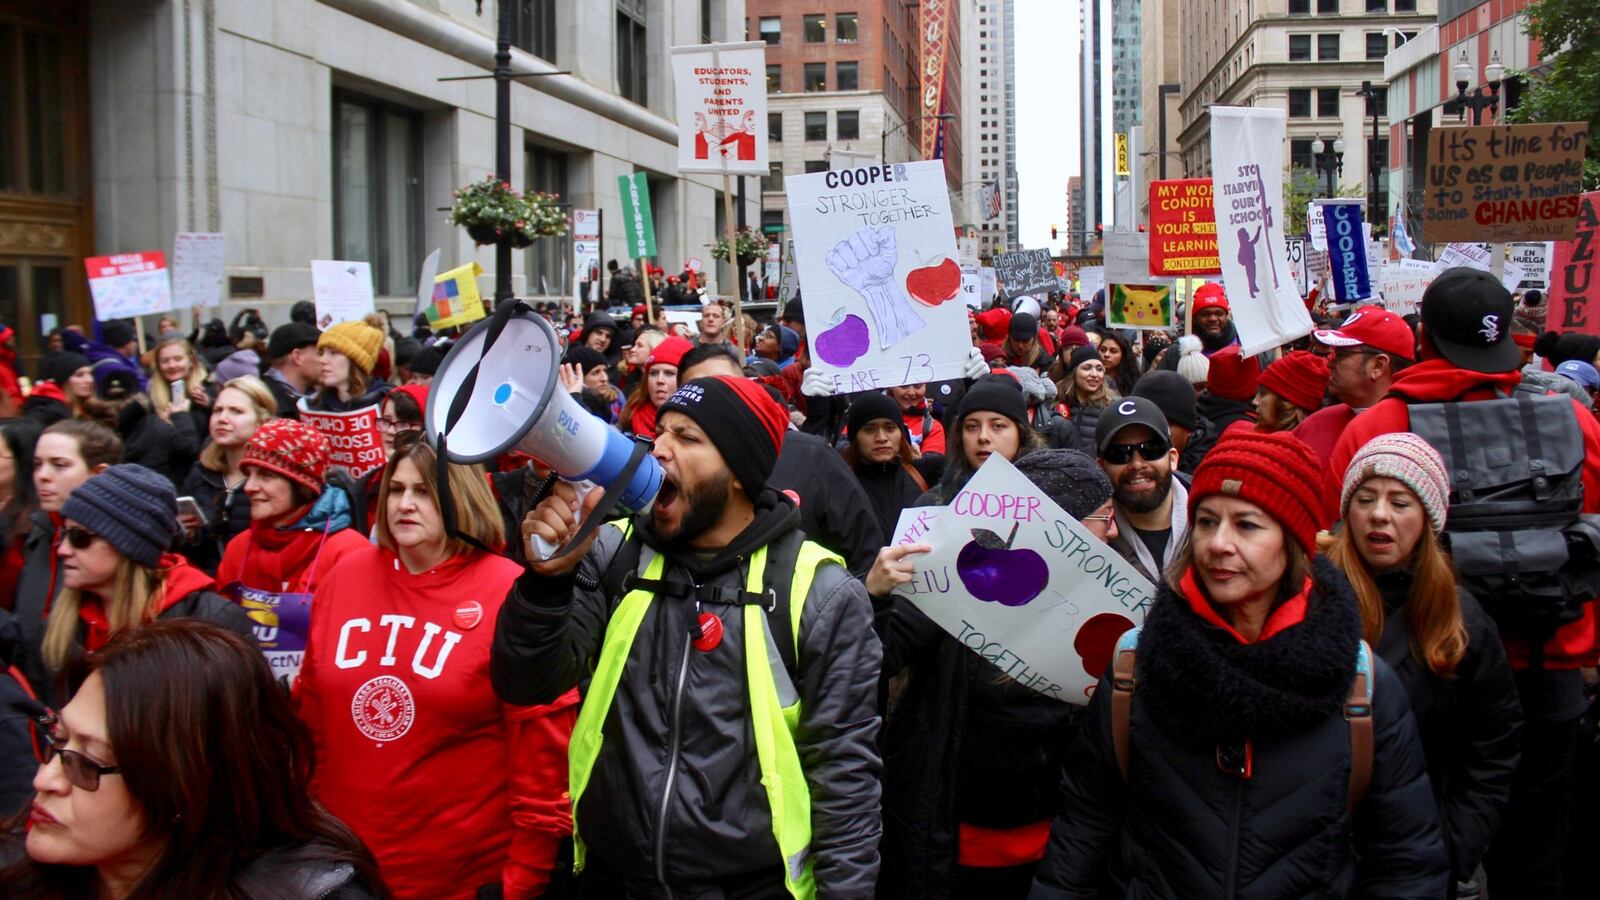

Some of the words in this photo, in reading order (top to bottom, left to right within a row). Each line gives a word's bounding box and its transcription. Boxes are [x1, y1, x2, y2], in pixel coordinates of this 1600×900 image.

[925, 0, 941, 107] ace
[694, 68, 752, 76] EDUCATORS,
[699, 78, 748, 86] STUDENTS,
[708, 108, 740, 116] UNITED
[1118, 134, 1126, 172] PARK
[1439, 129, 1477, 163] It's
[1486, 126, 1543, 159] time
[1547, 125, 1587, 152] for
[825, 164, 909, 189] COOPER
[1238, 164, 1257, 177] STO
[1499, 164, 1519, 182] a
[1158, 186, 1178, 197] MY
[1223, 180, 1258, 195] STARVI
[1434, 187, 1463, 207] to
[816, 188, 917, 214] STRONGER
[1232, 197, 1255, 210] OUR
[1475, 196, 1580, 225] CHANGES
[857, 204, 939, 226] TOGETHER
[1183, 211, 1196, 222] IS
[1230, 210, 1262, 225] SCHOO
[1156, 223, 1190, 235] YOUR
[1163, 240, 1218, 252] LEARNIN
[1334, 205, 1361, 300] COOPER
[993, 251, 1033, 268] FIGHTING
[1035, 248, 1051, 262] FOR
[1164, 258, 1221, 269] CONDITION
[1562, 198, 1600, 334] AZUE
[996, 267, 1014, 280] THE
[1041, 261, 1053, 275] OF
[830, 374, 844, 395] E
[850, 368, 880, 392] ARE
[899, 353, 934, 384] 73
[1118, 401, 1137, 415] C
[348, 415, 371, 432] DE
[558, 410, 580, 436] PYLE
[324, 432, 373, 449] ESCOL
[358, 447, 383, 462] LOS
[954, 490, 1046, 523] COOPER
[1044, 519, 1153, 617] STRONGER
[242, 591, 264, 602] CAL
[264, 595, 280, 605] 73
[1038, 590, 1080, 632] 73
[334, 614, 463, 679] CTU
[955, 618, 1063, 699] TOGETHER
[353, 685, 371, 719] CHICAGO
[374, 679, 407, 698] TEACHERS
